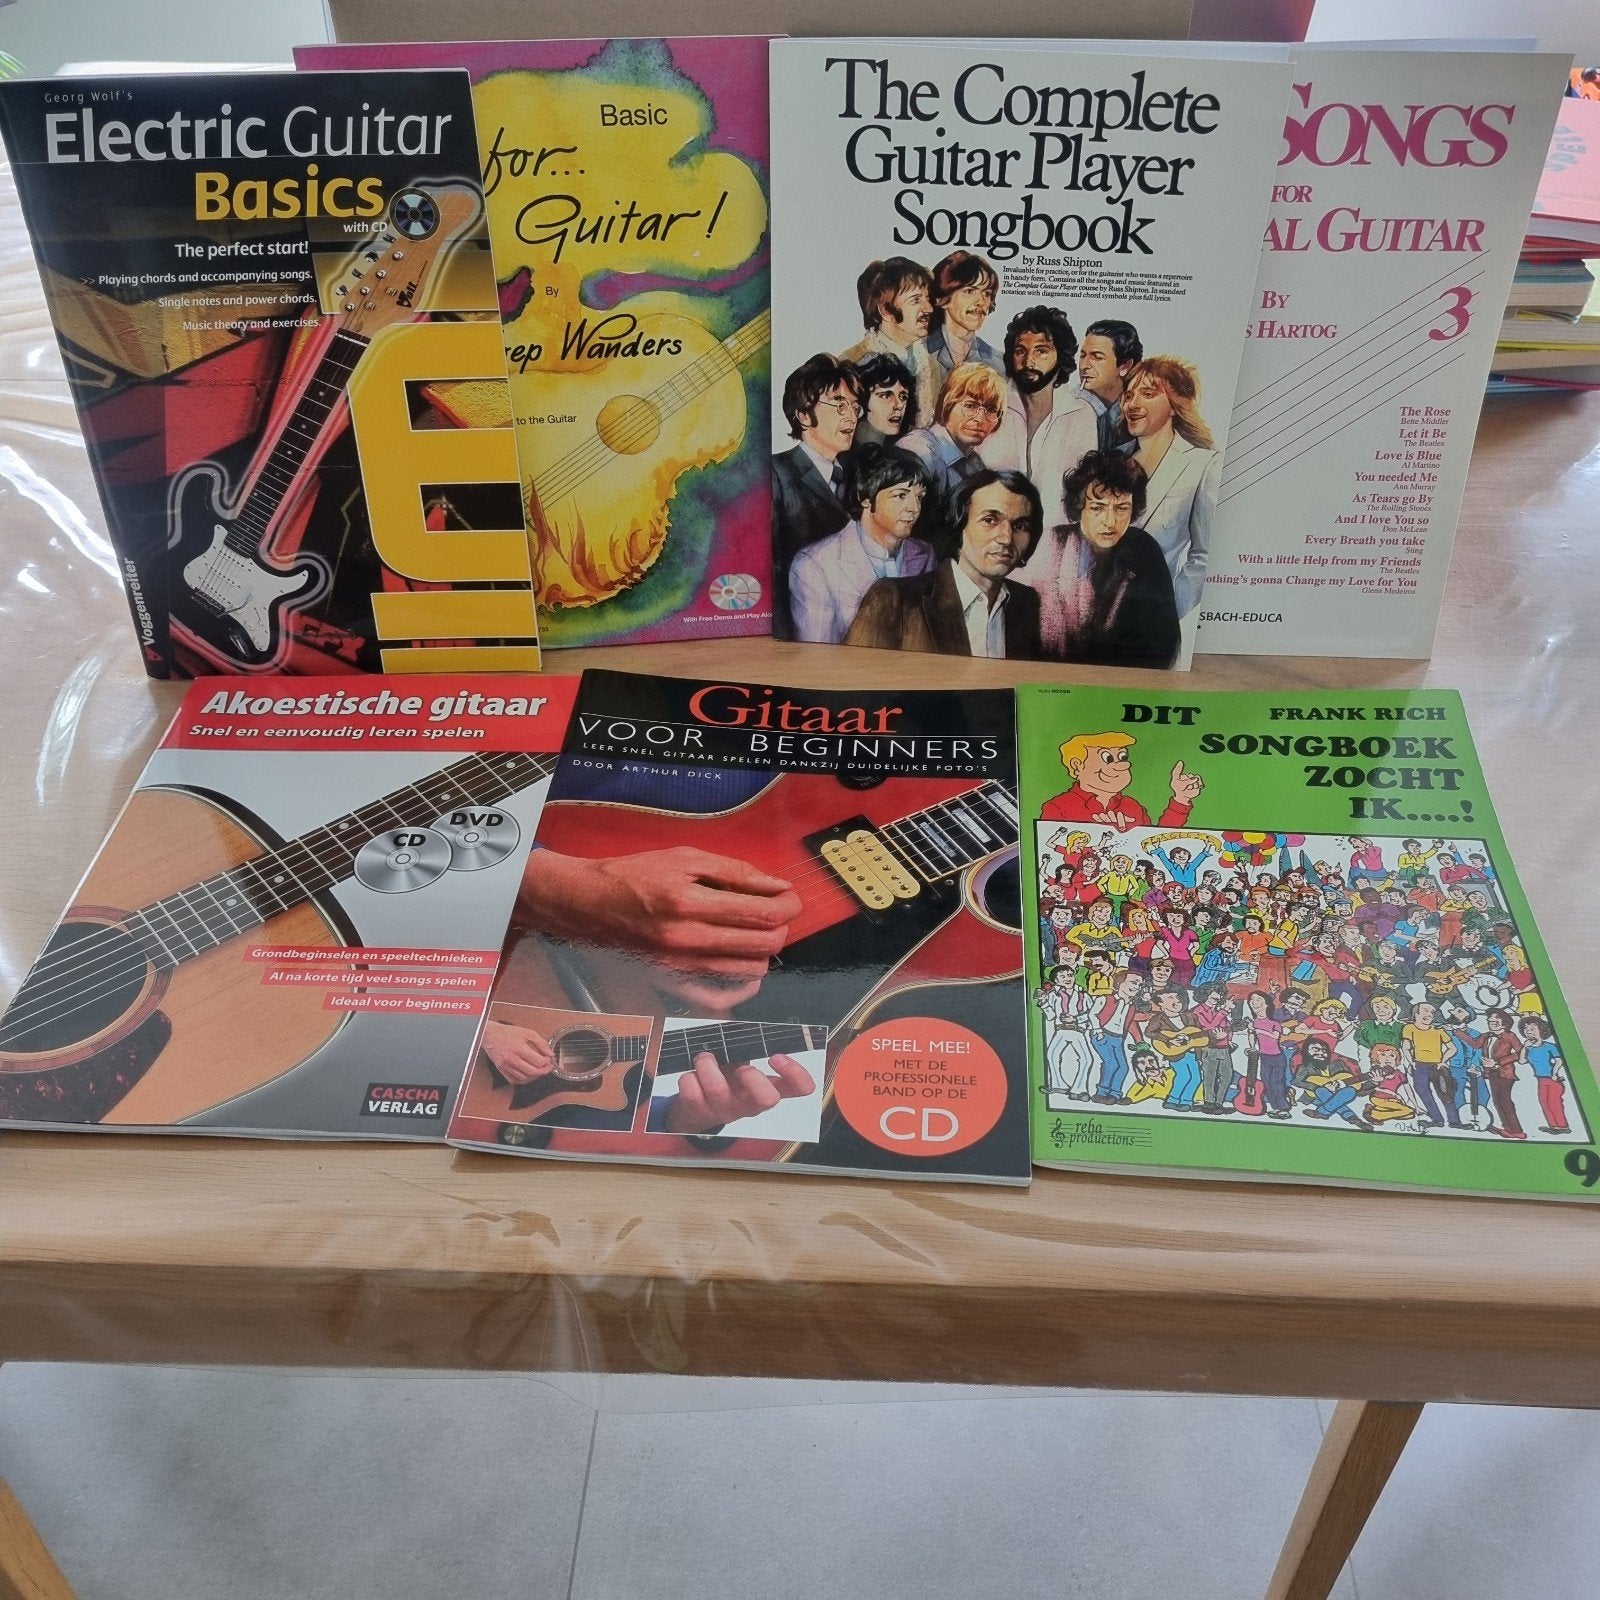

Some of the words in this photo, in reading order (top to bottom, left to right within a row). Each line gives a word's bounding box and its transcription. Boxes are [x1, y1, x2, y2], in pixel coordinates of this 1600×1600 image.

[44, 93, 85, 104] Georg
[90, 90, 134, 101] Wolf's
[825, 57, 941, 122] The
[953, 62, 1221, 143] Complete
[600, 103, 668, 127] Basic
[45, 103, 268, 163] Electric
[283, 103, 452, 157] Guitar
[844, 123, 1021, 189] Guitar
[1025, 131, 1195, 205] Player
[195, 164, 383, 221] Basics
[1271, 185, 1313, 203] FOR
[343, 221, 368, 234] with
[370, 221, 388, 233] CD
[893, 188, 1156, 261] Songbook
[1316, 206, 1486, 253] GUITAR
[175, 243, 204, 258] The
[207, 241, 264, 260] perfect
[268, 240, 309, 255] start!
[1022, 255, 1035, 267] by
[1036, 257, 1061, 267] Russ
[1063, 257, 1103, 269] Shipton
[98, 274, 138, 287] Playing
[140, 272, 176, 284] chords
[178, 271, 198, 283] and
[201, 270, 278, 285] accompanying
[280, 270, 313, 282] songs.
[545, 286, 559, 298] By
[158, 297, 189, 309] Single
[192, 296, 220, 307] notes
[222, 295, 243, 306] and
[245, 295, 276, 308] power
[279, 293, 317, 305] chords.
[1428, 286, 1472, 341] 3
[183, 320, 212, 331] Music
[214, 320, 248, 332] theory
[251, 319, 270, 330] and
[272, 317, 322, 329] exercises.
[1257, 320, 1338, 339] HARTOG
[560, 313, 682, 361] Wanders
[1400, 406, 1421, 417] The
[1424, 406, 1451, 417] Rose
[516, 417, 527, 426] to
[528, 416, 545, 425] the
[547, 414, 577, 425] Guitar
[1399, 428, 1418, 439] Let
[1420, 428, 1429, 439] it
[1432, 428, 1447, 439] Be
[1375, 450, 1402, 460] Love
[1405, 450, 1414, 460] is
[1417, 450, 1442, 460] Blue
[1355, 472, 1375, 482] You
[1378, 472, 1417, 482] needed
[1419, 472, 1438, 482] Me
[1352, 493, 1367, 503] As
[1370, 494, 1400, 504] Tears
[1401, 496, 1415, 506] go
[1418, 494, 1433, 506] By
[1334, 514, 1358, 525] And
[1360, 515, 1366, 524] I
[1369, 515, 1391, 525] love
[1395, 515, 1414, 525] You
[1305, 535, 1337, 546] Every
[1339, 535, 1376, 545] Breath
[1378, 538, 1399, 548] you
[1402, 537, 1425, 546] take
[1238, 554, 1264, 564] With
[1275, 555, 1300, 565] little
[1303, 555, 1329, 567] Help
[1331, 555, 1357, 566] from
[1360, 558, 1377, 568] my
[1380, 556, 1422, 567] Friends
[1250, 577, 1283, 586] gonna
[1285, 575, 1326, 587] Change
[1328, 579, 1346, 588] my
[1348, 577, 1375, 587] Love
[1377, 577, 1394, 587] for
[1397, 577, 1417, 588] You
[124, 557, 155, 646] Voggenreiter
[714, 614, 733, 622] Demo
[200, 690, 423, 716] Akoestische
[428, 690, 546, 721] gitaar
[688, 685, 903, 734] Gitaar
[1120, 703, 1202, 726] DIT
[1269, 706, 1367, 721] FRANK
[1373, 706, 1447, 722] RICH
[189, 725, 233, 737] Snel
[236, 727, 259, 737] en
[264, 726, 364, 740] eenvoudig
[370, 727, 417, 738] leren
[422, 728, 485, 740] spelen
[578, 716, 705, 748] VOOR
[750, 735, 999, 760] BEGINNERS
[1199, 733, 1459, 760] SONGBOEK
[582, 742, 617, 753] LEER
[622, 746, 656, 757] SNEL
[663, 750, 715, 761] GITAAR
[722, 755, 772, 766] SPELEN
[779, 759, 840, 770] DANKZIJ
[847, 762, 929, 772] DUIDELIJKE
[936, 764, 988, 773] FOTO'S
[572, 759, 614, 770] DOOR
[621, 765, 679, 777] ARTHUR
[687, 771, 723, 781] DICK
[1304, 765, 1465, 791] ZOCHT
[450, 812, 504, 827] DVD
[393, 833, 426, 847] CD
[252, 949, 359, 962] Grondbeginselen
[363, 952, 378, 961] en
[380, 952, 483, 964] speeltechnieken
[270, 971, 284, 981] Al
[286, 973, 301, 981] na
[305, 972, 338, 982] korte
[341, 973, 363, 984] tijd
[366, 974, 391, 983] veel
[394, 976, 431, 986] songs
[434, 976, 477, 987] spelen
[331, 996, 371, 1006] Ideaal
[373, 999, 403, 1007] voor
[406, 998, 471, 1010] beginners
[871, 1038, 922, 1053] SPEEL
[929, 1040, 971, 1054] MEE!
[893, 1059, 923, 1070] MET
[928, 1060, 948, 1071] DE
[864, 1071, 977, 1085] PROFESSIONELE
[370, 1086, 440, 1101] CASCHA
[873, 1086, 916, 1097] BAND
[921, 1088, 943, 1098] OP
[947, 1089, 968, 1099] DE
[368, 1101, 438, 1115] VERLAG
[879, 1106, 960, 1142] CD
[1069, 1133, 1135, 1148] productions
[1564, 1149, 1600, 1187] 9
